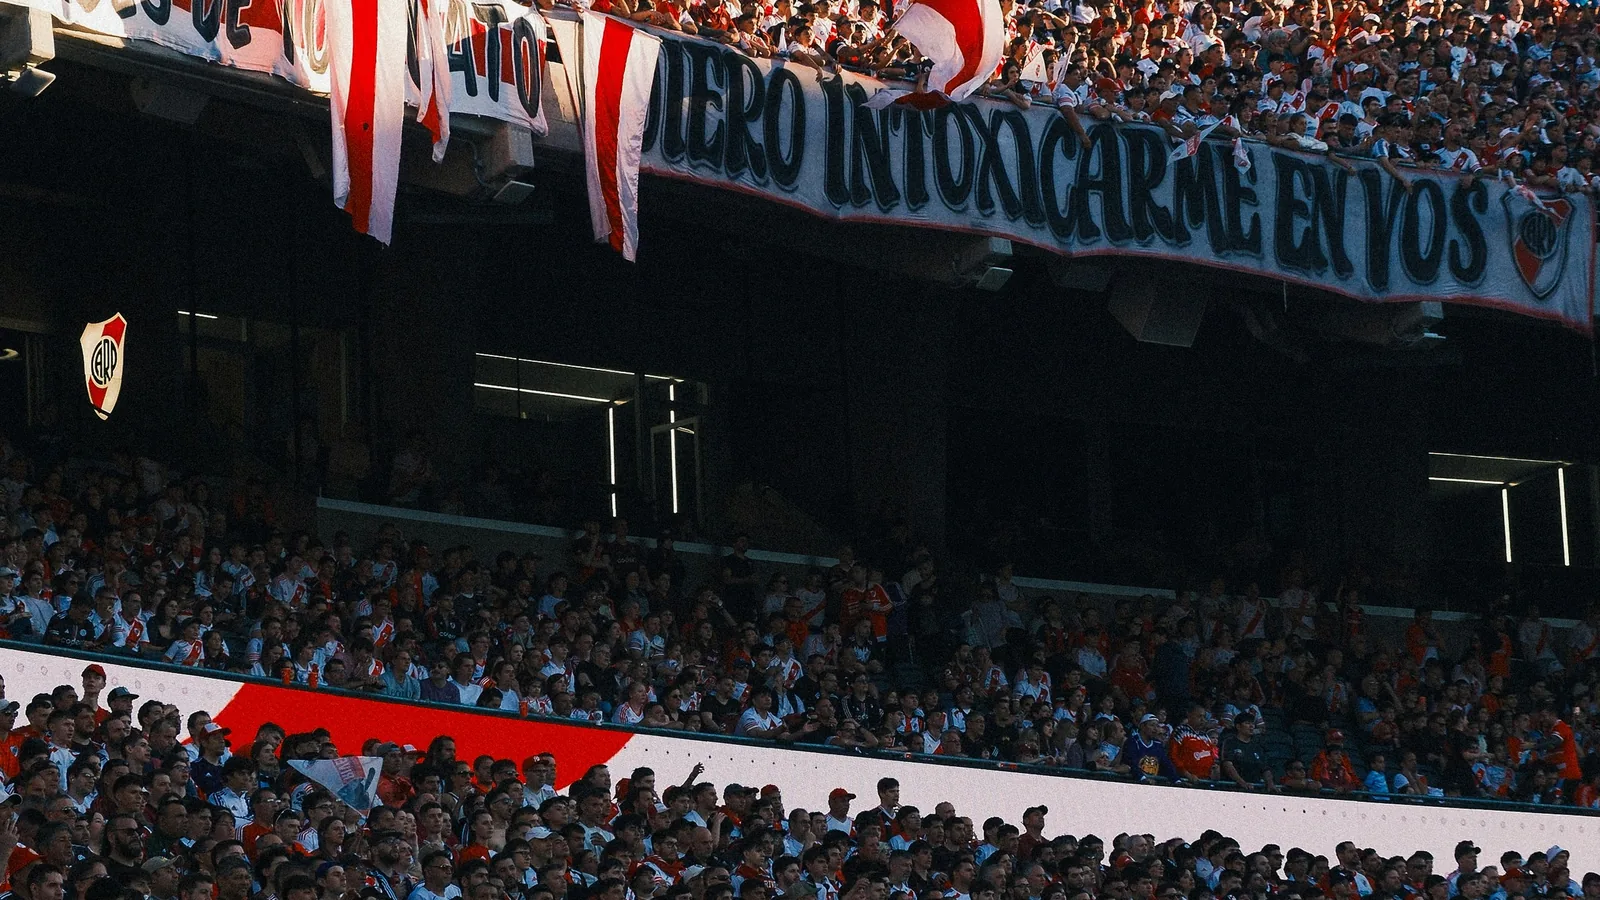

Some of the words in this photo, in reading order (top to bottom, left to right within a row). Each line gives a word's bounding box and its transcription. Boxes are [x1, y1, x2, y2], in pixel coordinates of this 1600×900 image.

[822, 74, 1263, 257] INTOXICARME
[1271, 152, 1354, 280] EN
[1357, 168, 1489, 292] VOS
